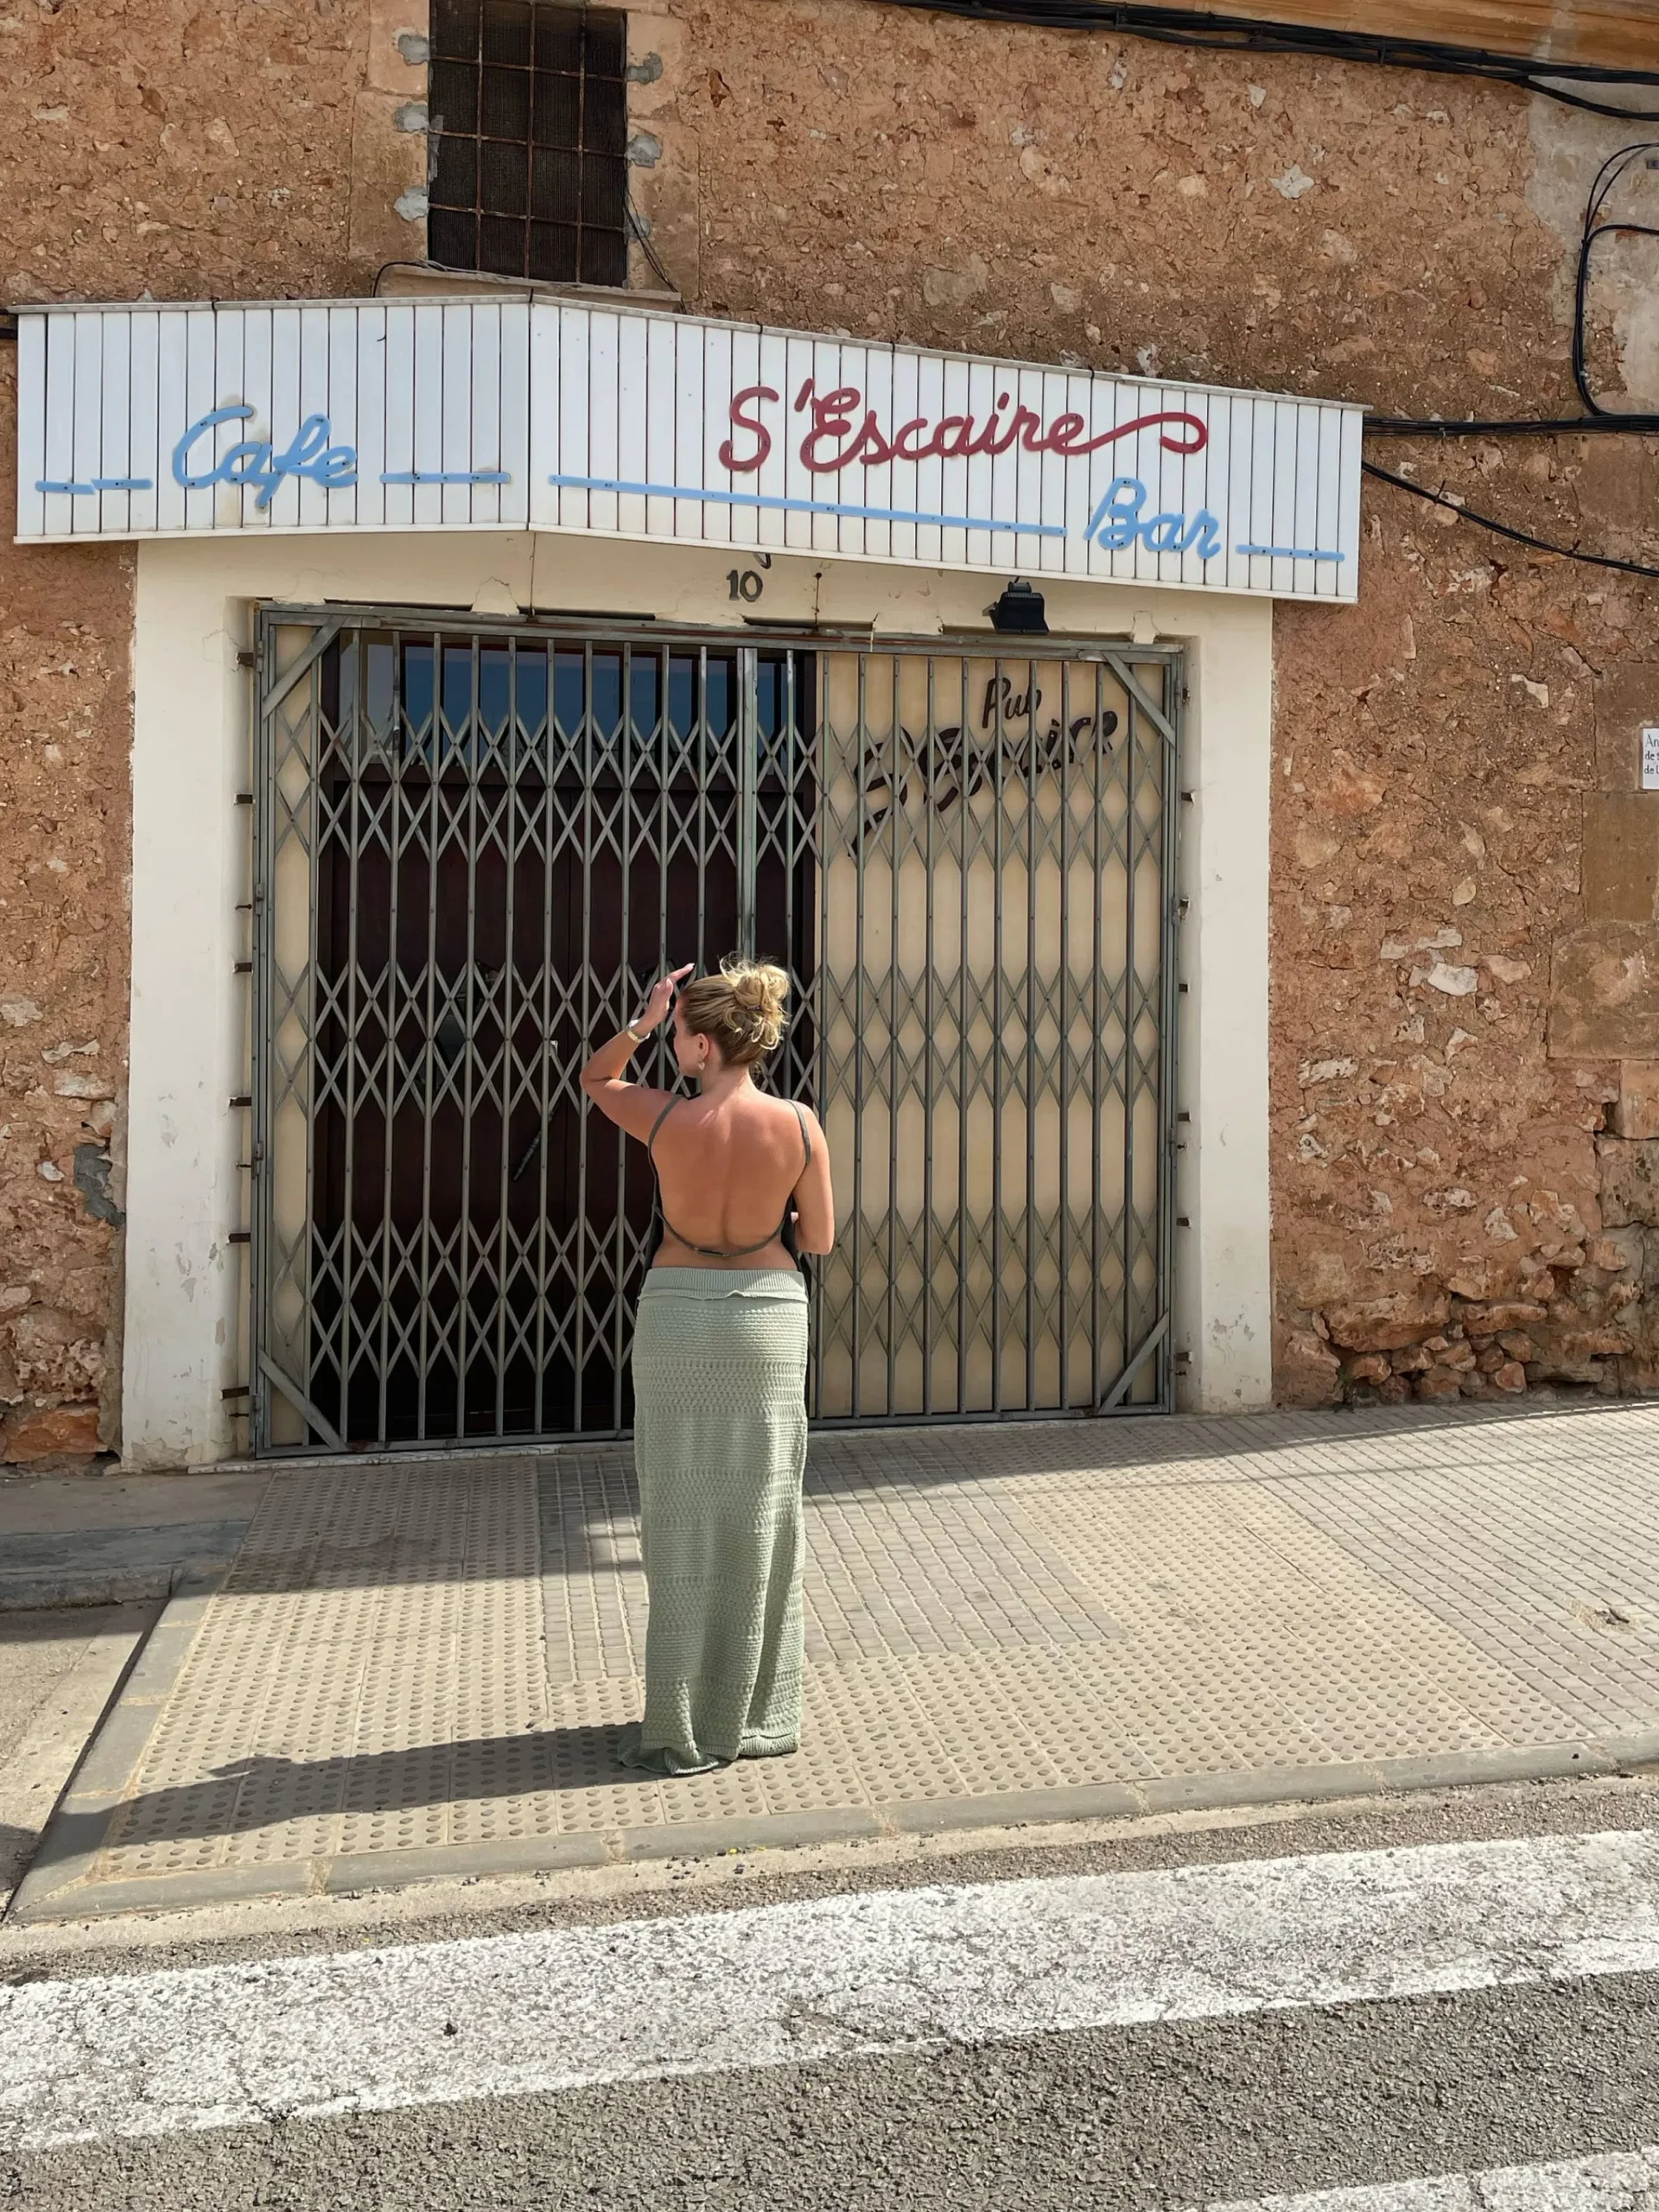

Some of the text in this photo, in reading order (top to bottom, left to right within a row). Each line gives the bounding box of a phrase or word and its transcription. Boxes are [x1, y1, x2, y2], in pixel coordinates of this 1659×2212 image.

[719, 378, 1209, 473] S'Escaire
[173, 405, 359, 508] Cafe
[1084, 476, 1222, 559] Bar
[726, 569, 764, 603] 10
[982, 677, 1042, 729] Pub
[1643, 765, 1655, 774] de
[1644, 750, 1655, 760] de
